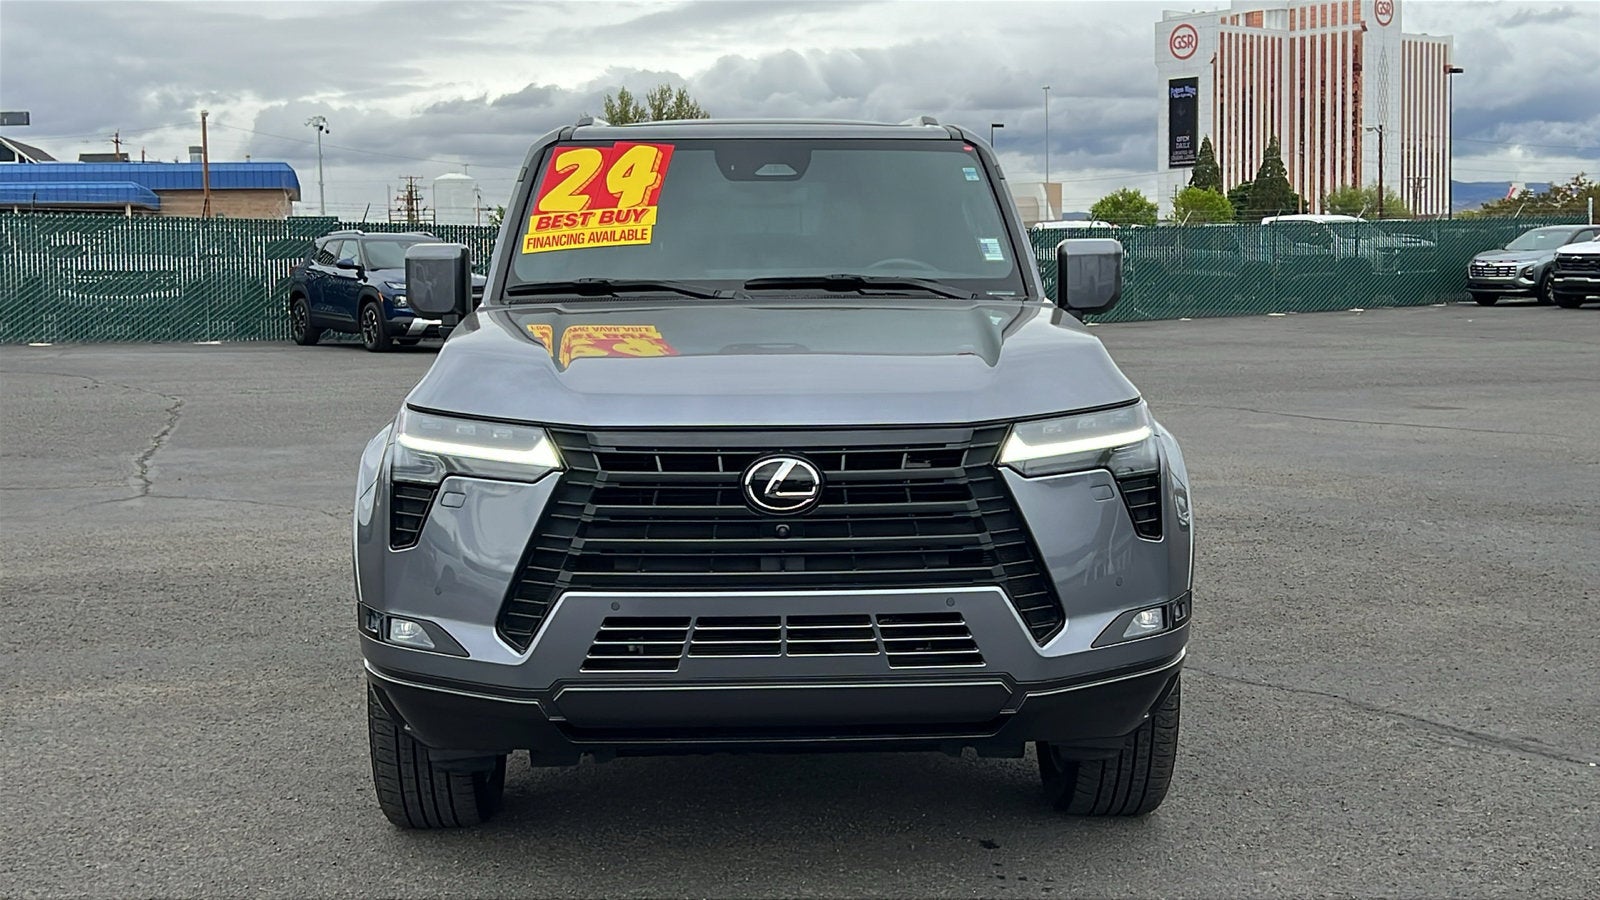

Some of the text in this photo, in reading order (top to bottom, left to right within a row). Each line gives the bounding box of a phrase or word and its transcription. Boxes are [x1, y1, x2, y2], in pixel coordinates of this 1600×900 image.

[1376, 1, 1393, 17] GSR
[1173, 34, 1195, 49] GSR
[538, 145, 663, 212] 24
[535, 209, 649, 231] BEST BUY
[526, 228, 648, 249] FINANCING AVAILABLE
